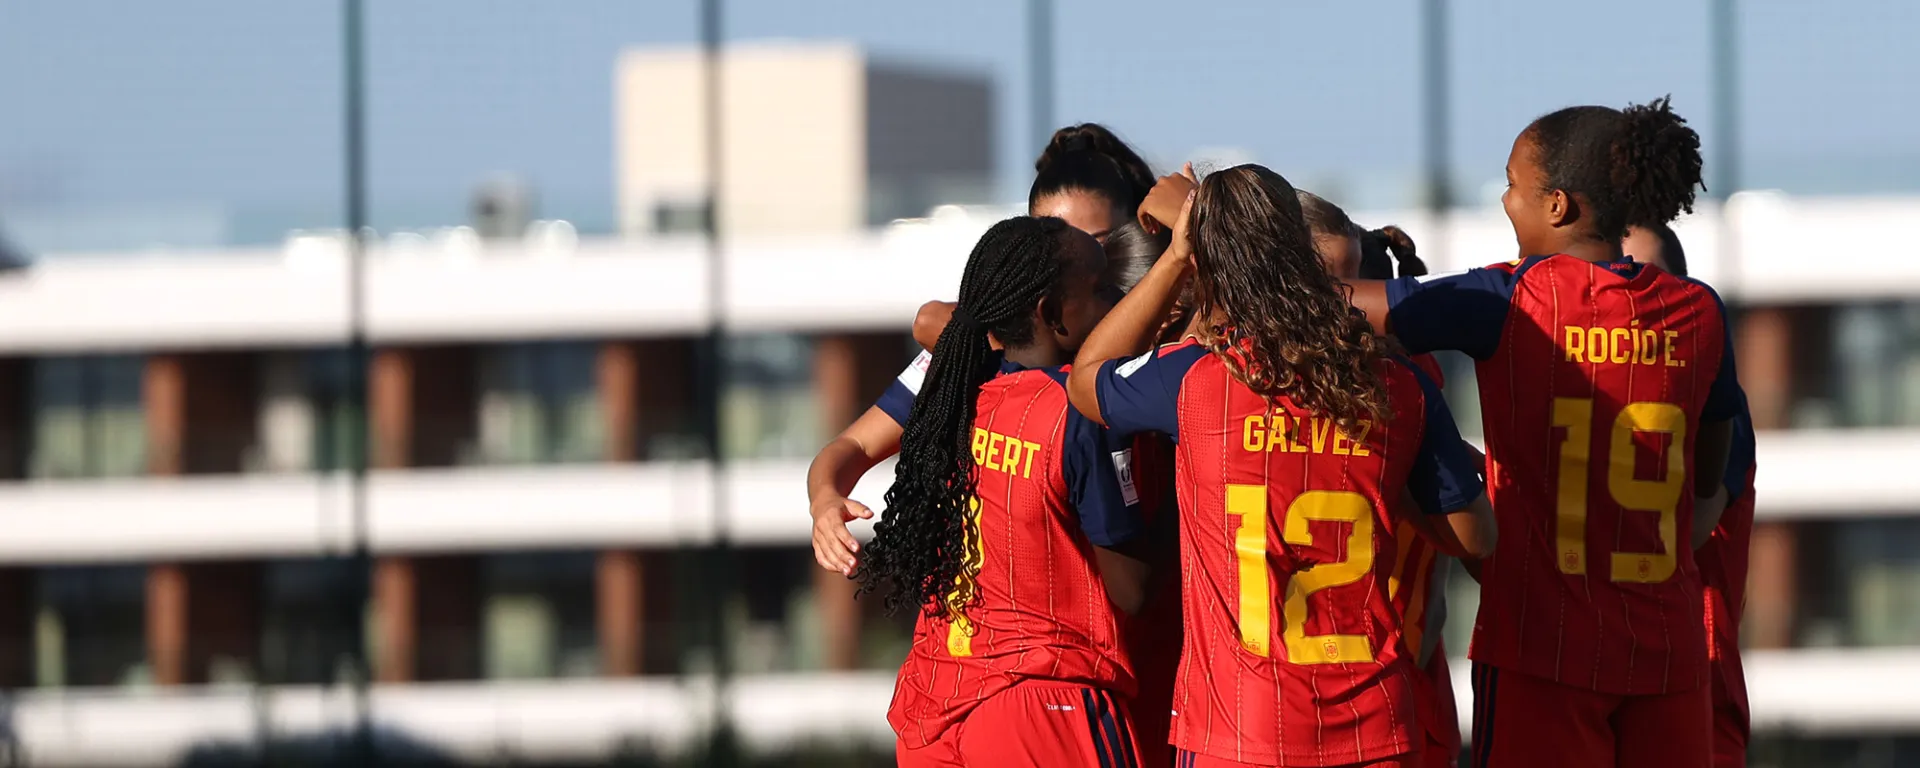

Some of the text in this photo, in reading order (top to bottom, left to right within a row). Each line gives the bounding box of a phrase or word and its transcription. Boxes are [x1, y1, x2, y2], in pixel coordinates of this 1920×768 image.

[1564, 319, 1686, 367] ROCÍO E.
[1243, 407, 1371, 456] GÁLVEZ
[1552, 397, 1686, 583] 19
[1226, 484, 1376, 664] 12
